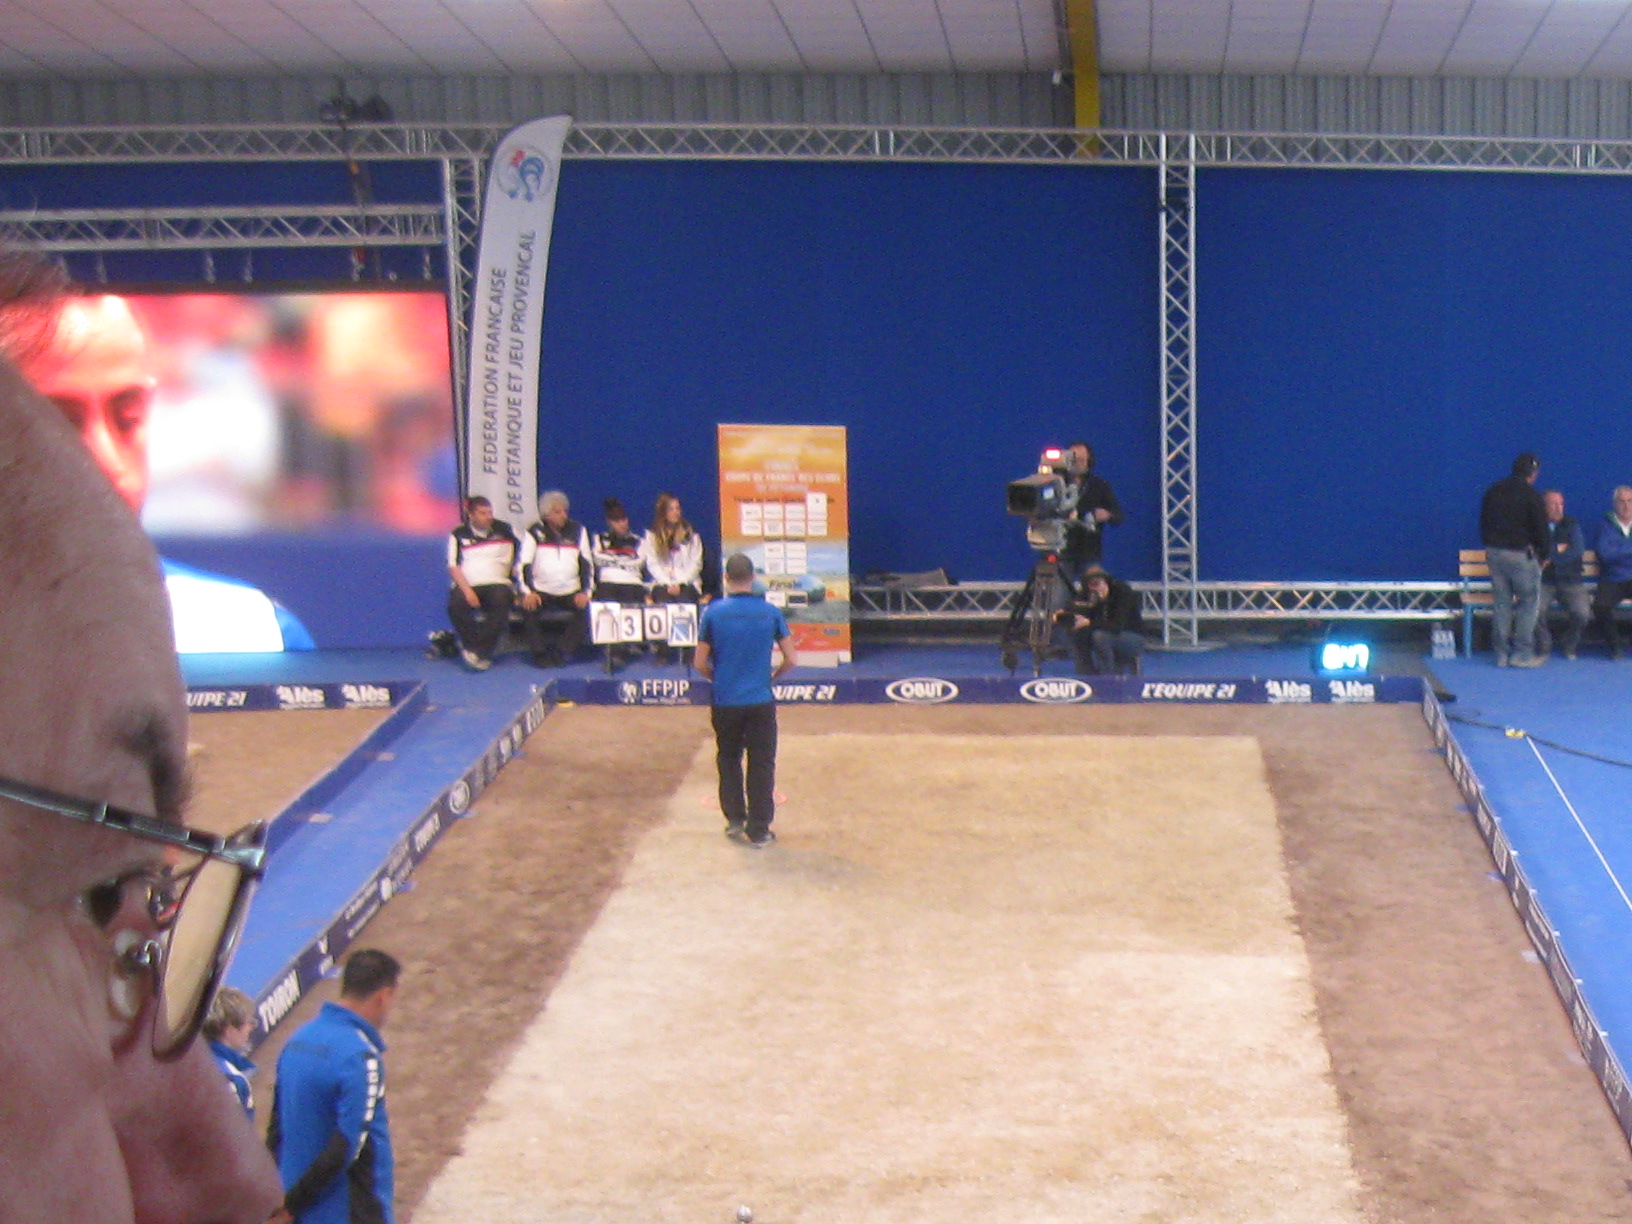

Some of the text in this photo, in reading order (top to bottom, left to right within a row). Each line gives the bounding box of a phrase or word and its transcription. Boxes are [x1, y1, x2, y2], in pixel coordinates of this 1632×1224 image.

[509, 337, 525, 370] JEU
[508, 372, 523, 393] ET
[483, 368, 499, 475] FEDERATION
[507, 397, 522, 487] PETANQUE
[507, 491, 523, 514] DE
[623, 614, 661, 637] 3 0
[642, 679, 690, 697] FFPJP
[900, 682, 944, 698] OBUT
[1034, 682, 1078, 698] OBUT
[1216, 684, 1237, 699] 21
